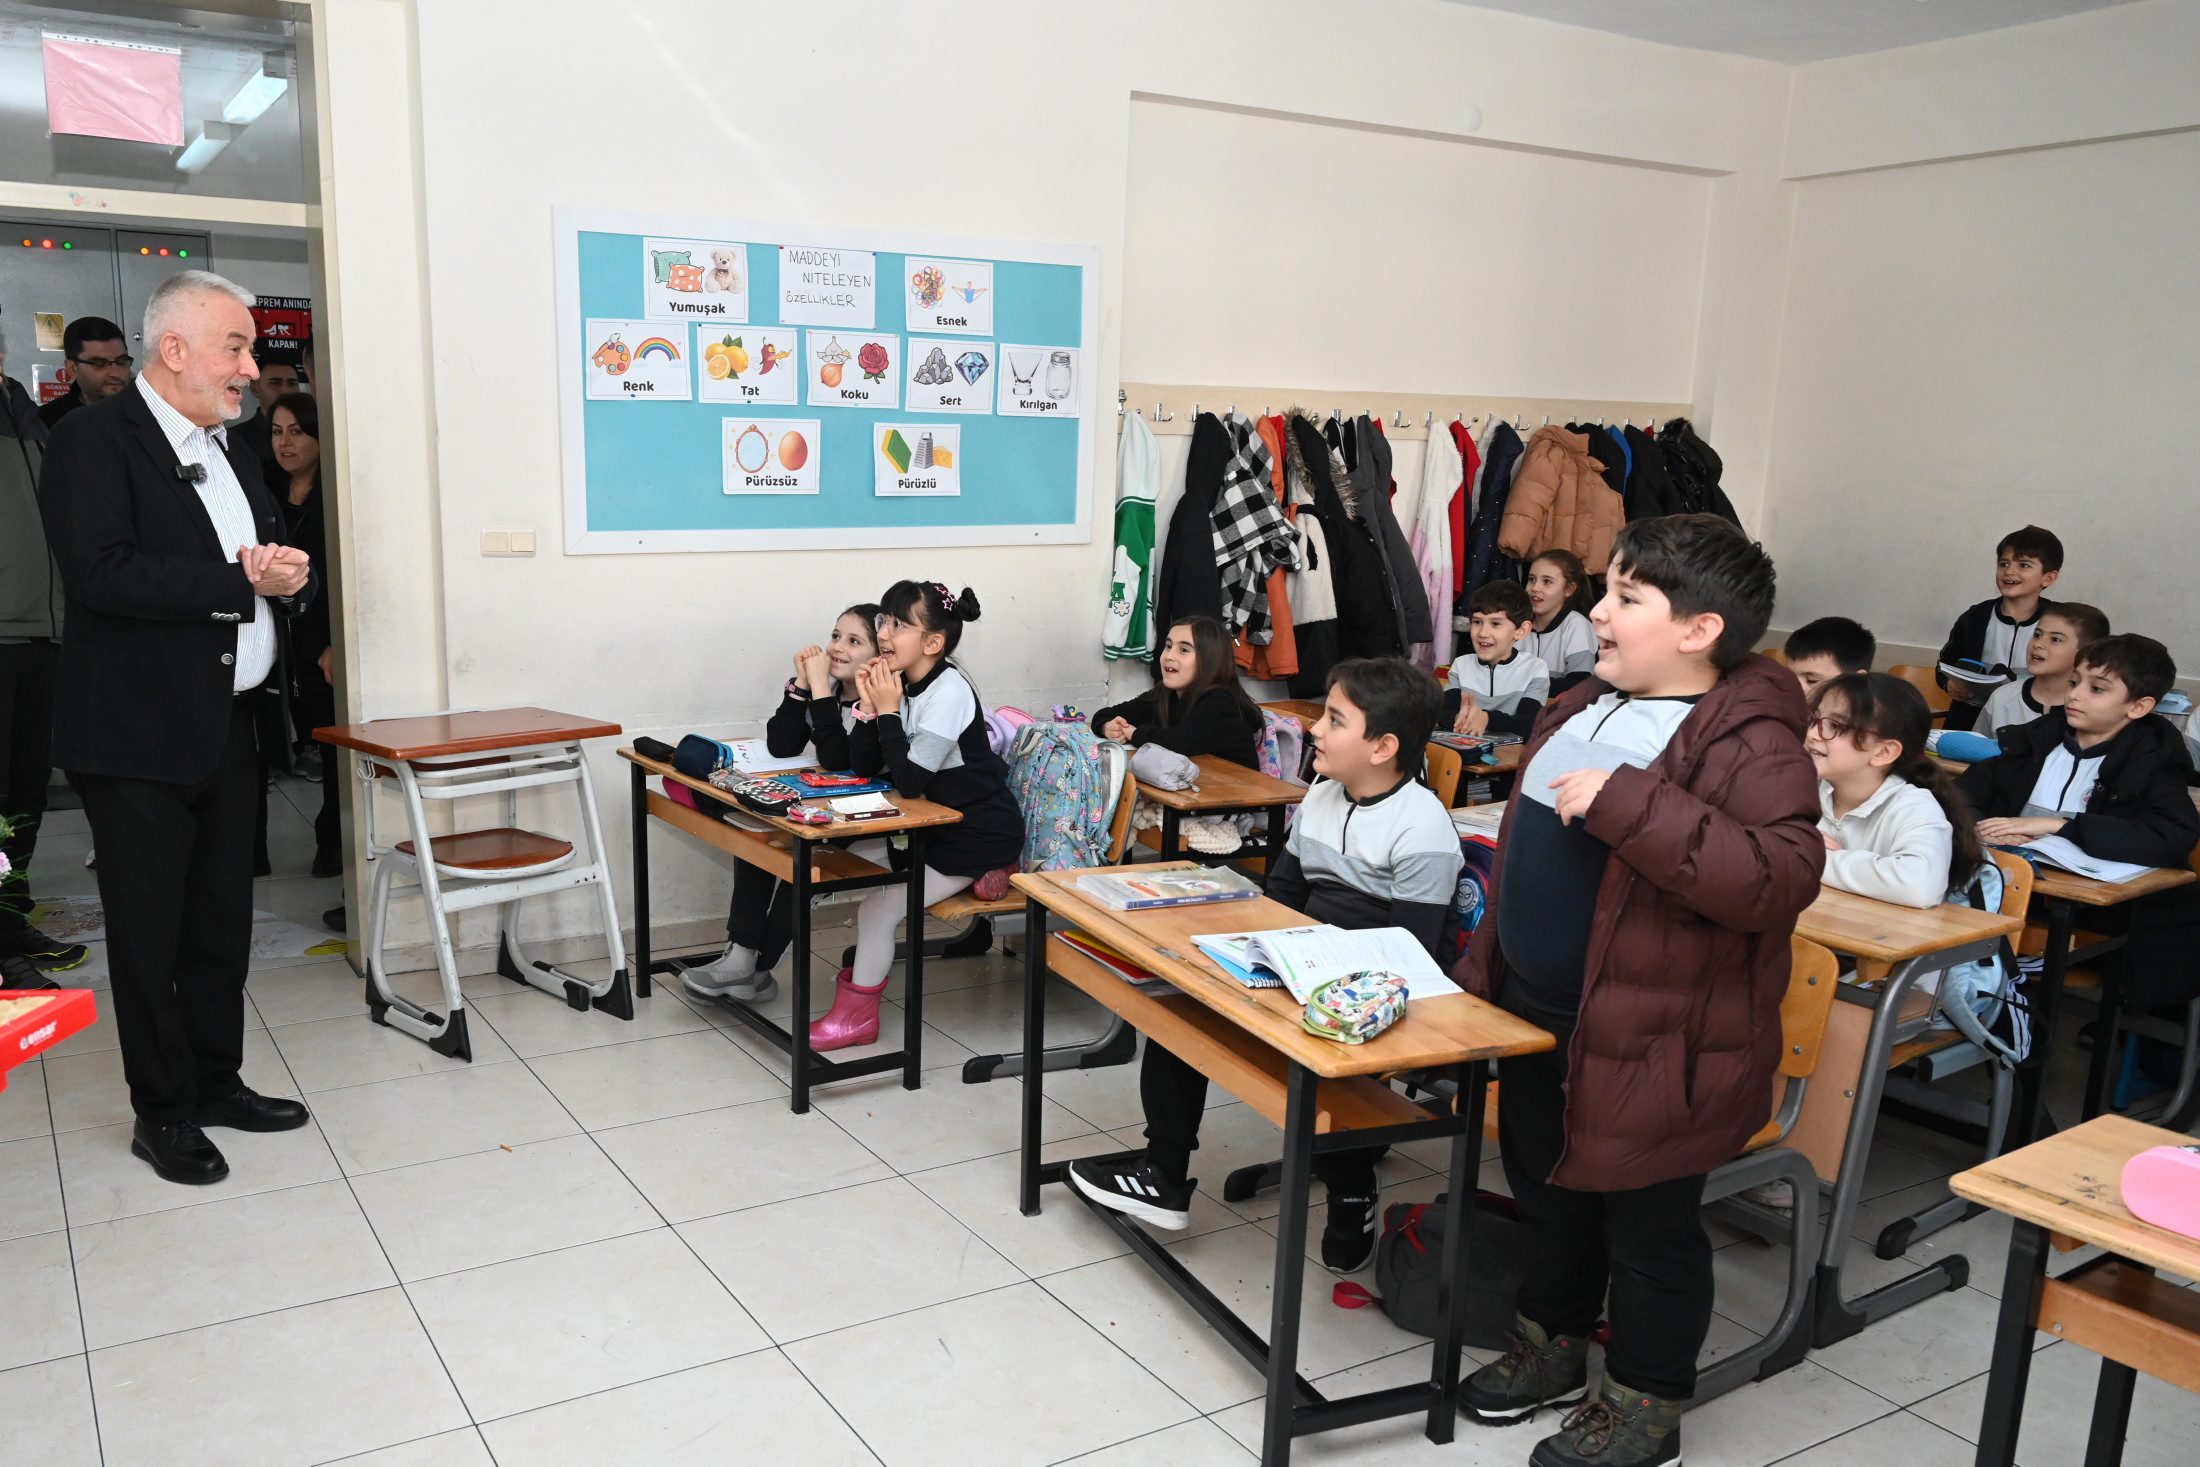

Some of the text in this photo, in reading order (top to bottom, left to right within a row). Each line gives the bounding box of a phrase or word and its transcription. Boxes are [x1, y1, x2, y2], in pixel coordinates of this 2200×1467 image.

[802, 270, 872, 287] NİTELEYEN
[255, 297, 281, 308] EPREM
[785, 290, 856, 308] ÖZELLİKLER
[669, 301, 726, 316] Yumuşak
[936, 315, 968, 327] Esnek
[268, 339, 298, 349] KAPAN!
[623, 380, 655, 392] Renk
[740, 385, 760, 396] Tat
[840, 389, 869, 400] Koku
[939, 395, 962, 406] Sert
[1019, 399, 1058, 412] Kırılgan
[745, 476, 799, 487] Pürüzsüz
[898, 478, 937, 489] Pürüzlü
